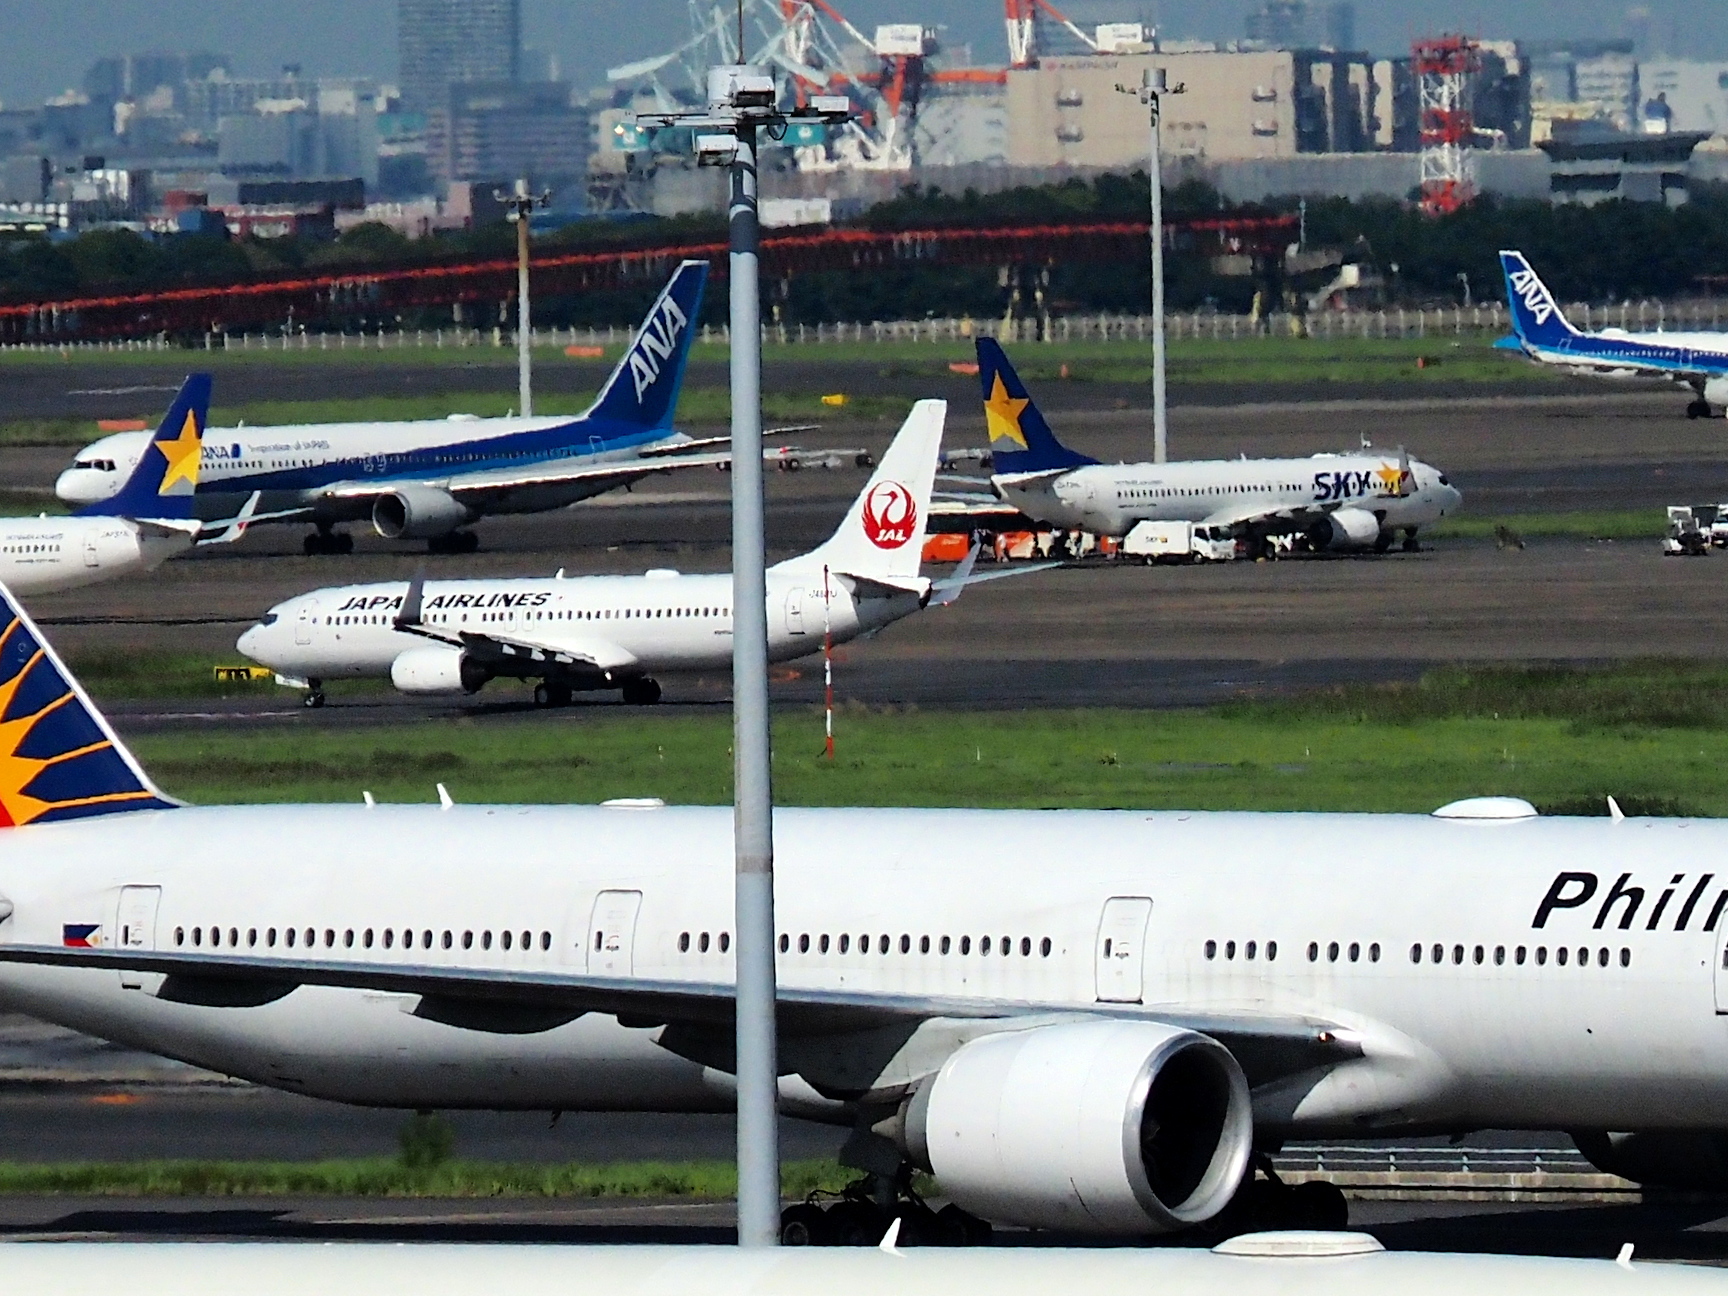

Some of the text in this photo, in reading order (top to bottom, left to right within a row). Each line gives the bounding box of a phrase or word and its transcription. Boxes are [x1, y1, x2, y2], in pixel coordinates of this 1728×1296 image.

[1508, 269, 1555, 326] ANA
[629, 294, 688, 405] ANA
[1313, 471, 1372, 500] SKY
[874, 528, 908, 542] JAL
[338, 593, 552, 611] JAPA AIRLINES
